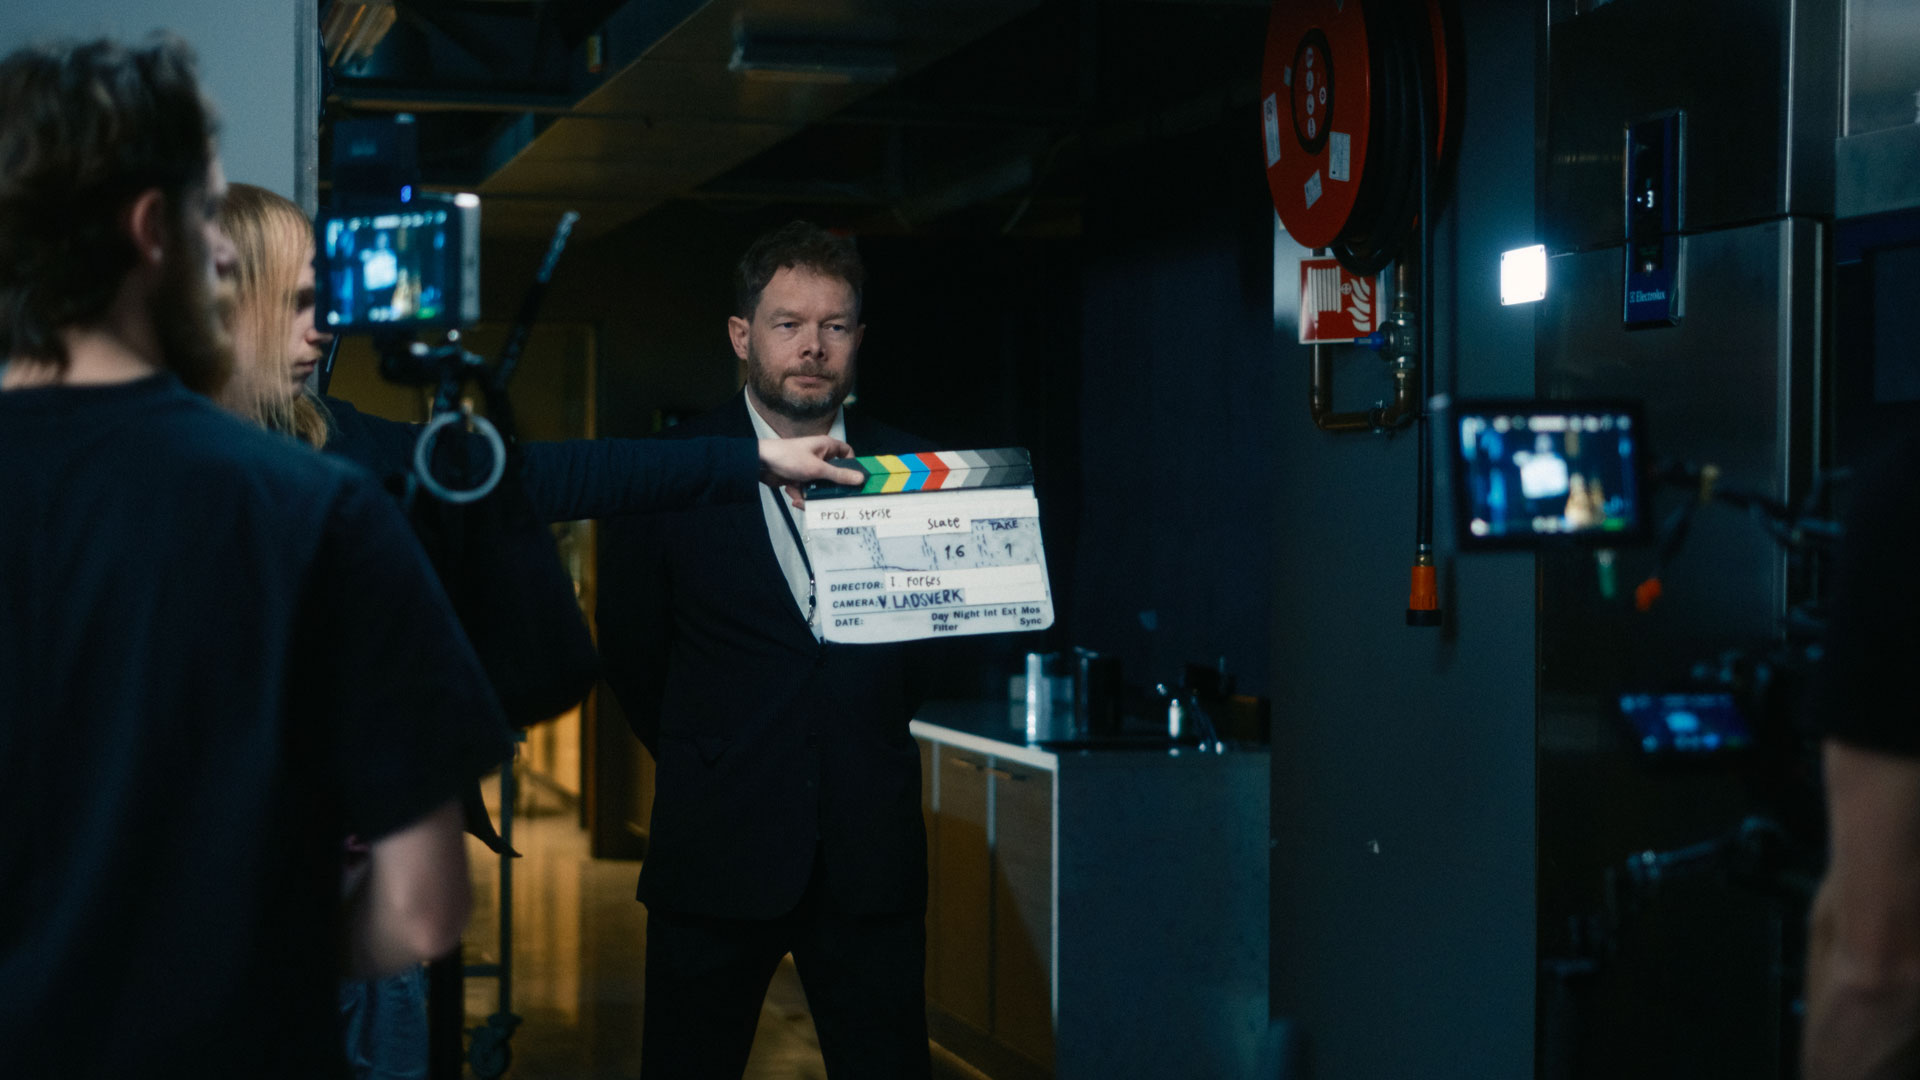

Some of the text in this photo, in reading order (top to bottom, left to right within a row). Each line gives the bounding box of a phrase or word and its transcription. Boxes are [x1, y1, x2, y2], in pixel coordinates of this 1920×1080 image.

[927, 517, 960, 530] Slate
[988, 520, 1019, 531] TAKE
[836, 527, 860, 535] ROLL
[830, 581, 884, 592] DIRECTOR:
[832, 598, 878, 609] CAMERA:
[931, 606, 1041, 623] Day Night Int Ext Mos
[835, 617, 864, 627] DATE:
[933, 623, 958, 632] Filter
[1020, 617, 1042, 627] Sync
